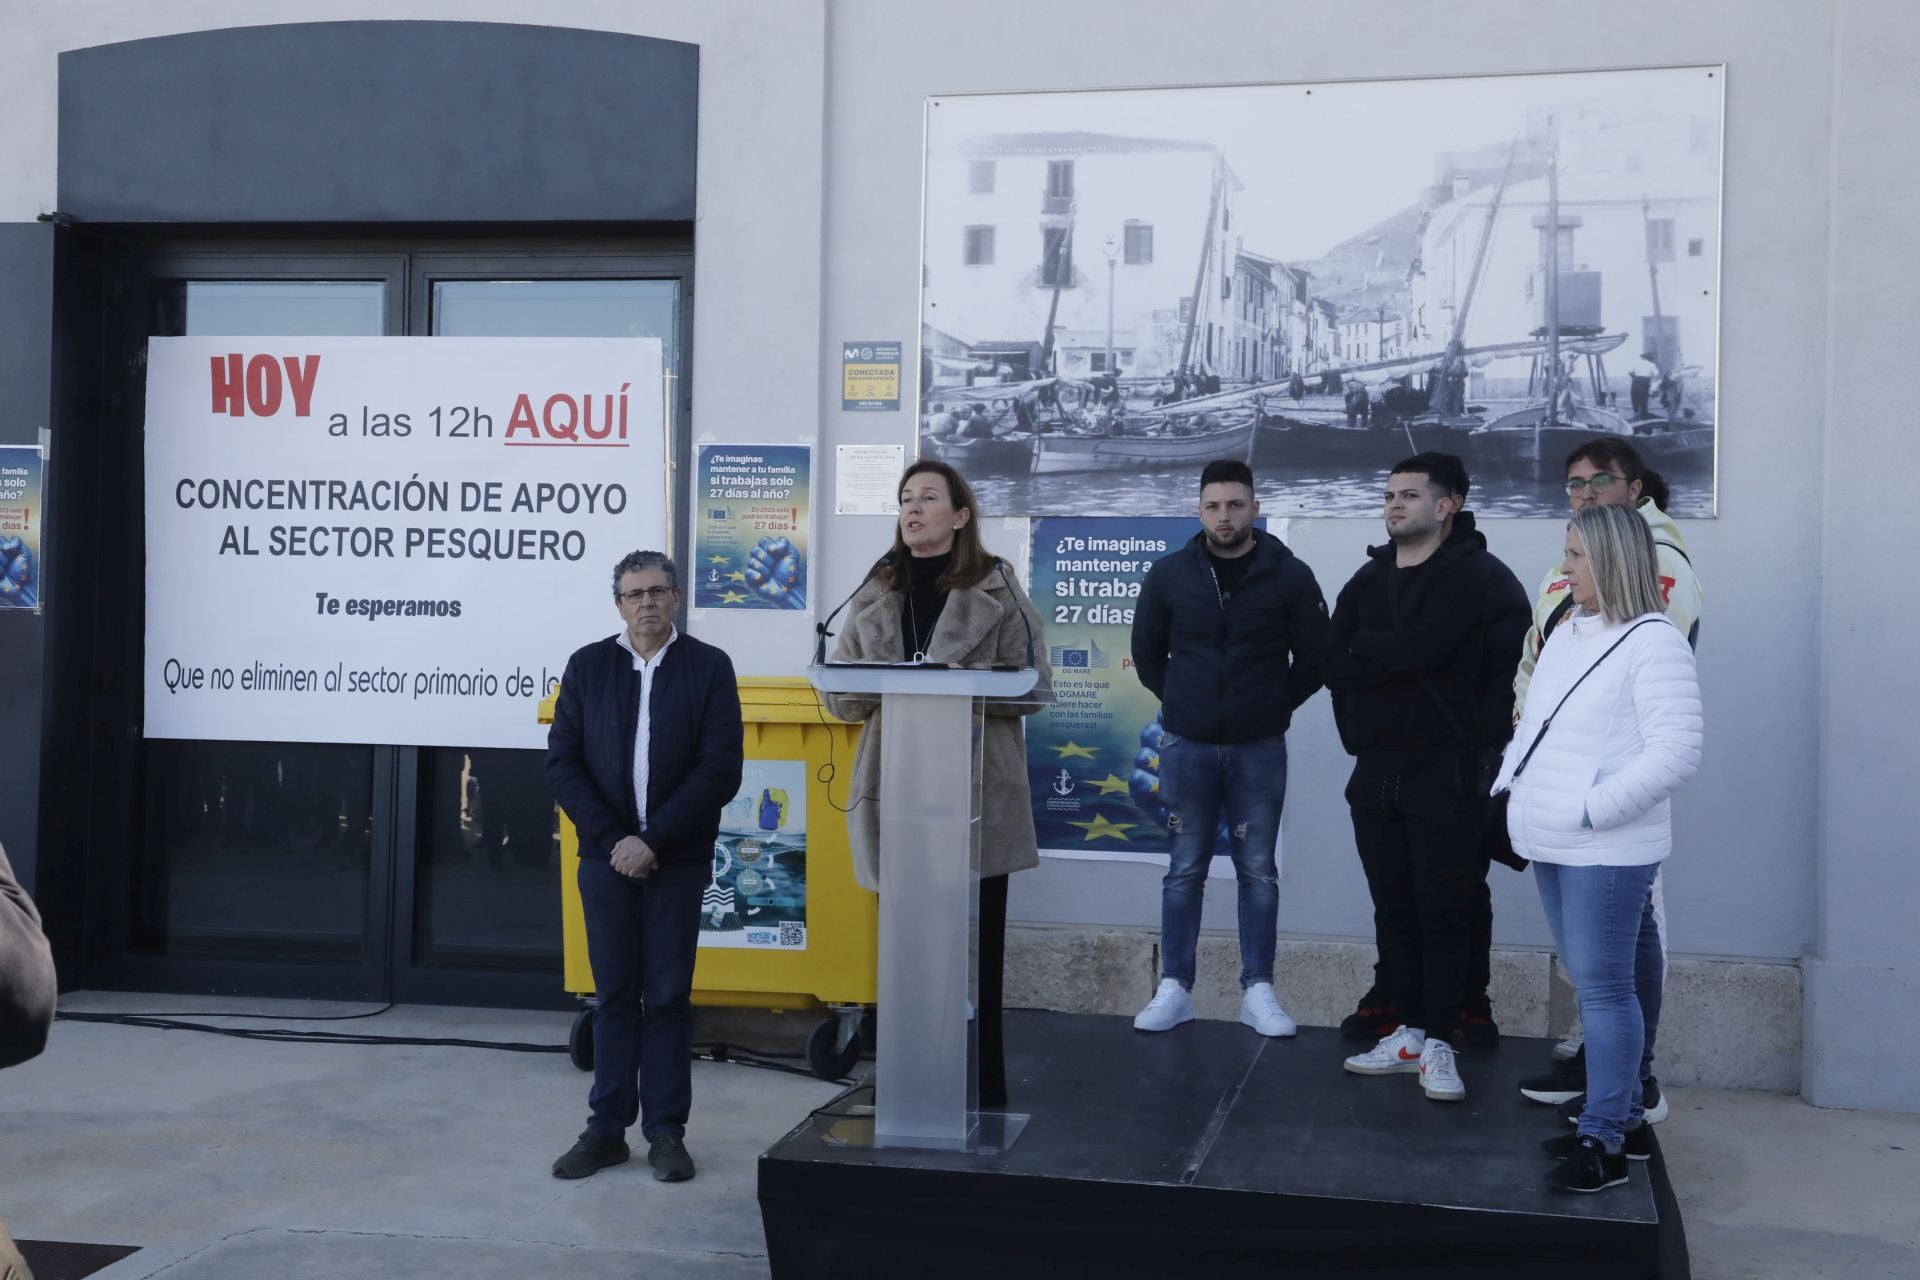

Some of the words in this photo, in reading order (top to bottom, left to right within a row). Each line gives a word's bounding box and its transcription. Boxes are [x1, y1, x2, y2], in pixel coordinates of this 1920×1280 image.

[210, 353, 321, 418] HOY
[328, 413, 349, 438] a
[363, 406, 412, 438] las
[428, 406, 494, 438] 12h
[505, 383, 631, 444] AQUÍ
[710, 455, 724, 464] ¿Te
[725, 455, 763, 464] imaginas
[2, 467, 28, 476] familia
[768, 466, 795, 474] familia
[4, 477, 26, 487] solo
[710, 475, 719, 485] si
[721, 476, 768, 488] trabajas
[770, 477, 793, 486] solo
[175, 473, 450, 513] CONCENTRACIÓN
[460, 482, 503, 513] DE
[511, 482, 627, 515] APOYO
[709, 489, 723, 498] 27
[750, 489, 761, 498] al
[762, 489, 790, 499] año?
[754, 522, 767, 530] 27
[219, 525, 259, 556] AL
[269, 526, 394, 558] SECTOR
[405, 528, 586, 561] PESQUERO
[1056, 537, 1085, 554] ¿Te
[1088, 537, 1166, 554] imaginas
[1055, 558, 1139, 572] mantener
[1055, 578, 1075, 597] si
[1079, 578, 1143, 598] traba
[315, 592, 340, 616] Te
[345, 597, 462, 622] esperamos
[1055, 605, 1083, 623] 27
[1087, 604, 1135, 625] días
[164, 658, 205, 694] Que
[210, 667, 235, 691] no
[241, 661, 318, 692] eliminen
[325, 663, 342, 693] al
[347, 669, 407, 694] sector
[414, 665, 498, 700] primario
[506, 667, 534, 697] de
[1094, 682, 1110, 690] que
[1059, 691, 1097, 699] DGMARE
[1078, 701, 1103, 709] hacer
[1080, 711, 1113, 719] familias
